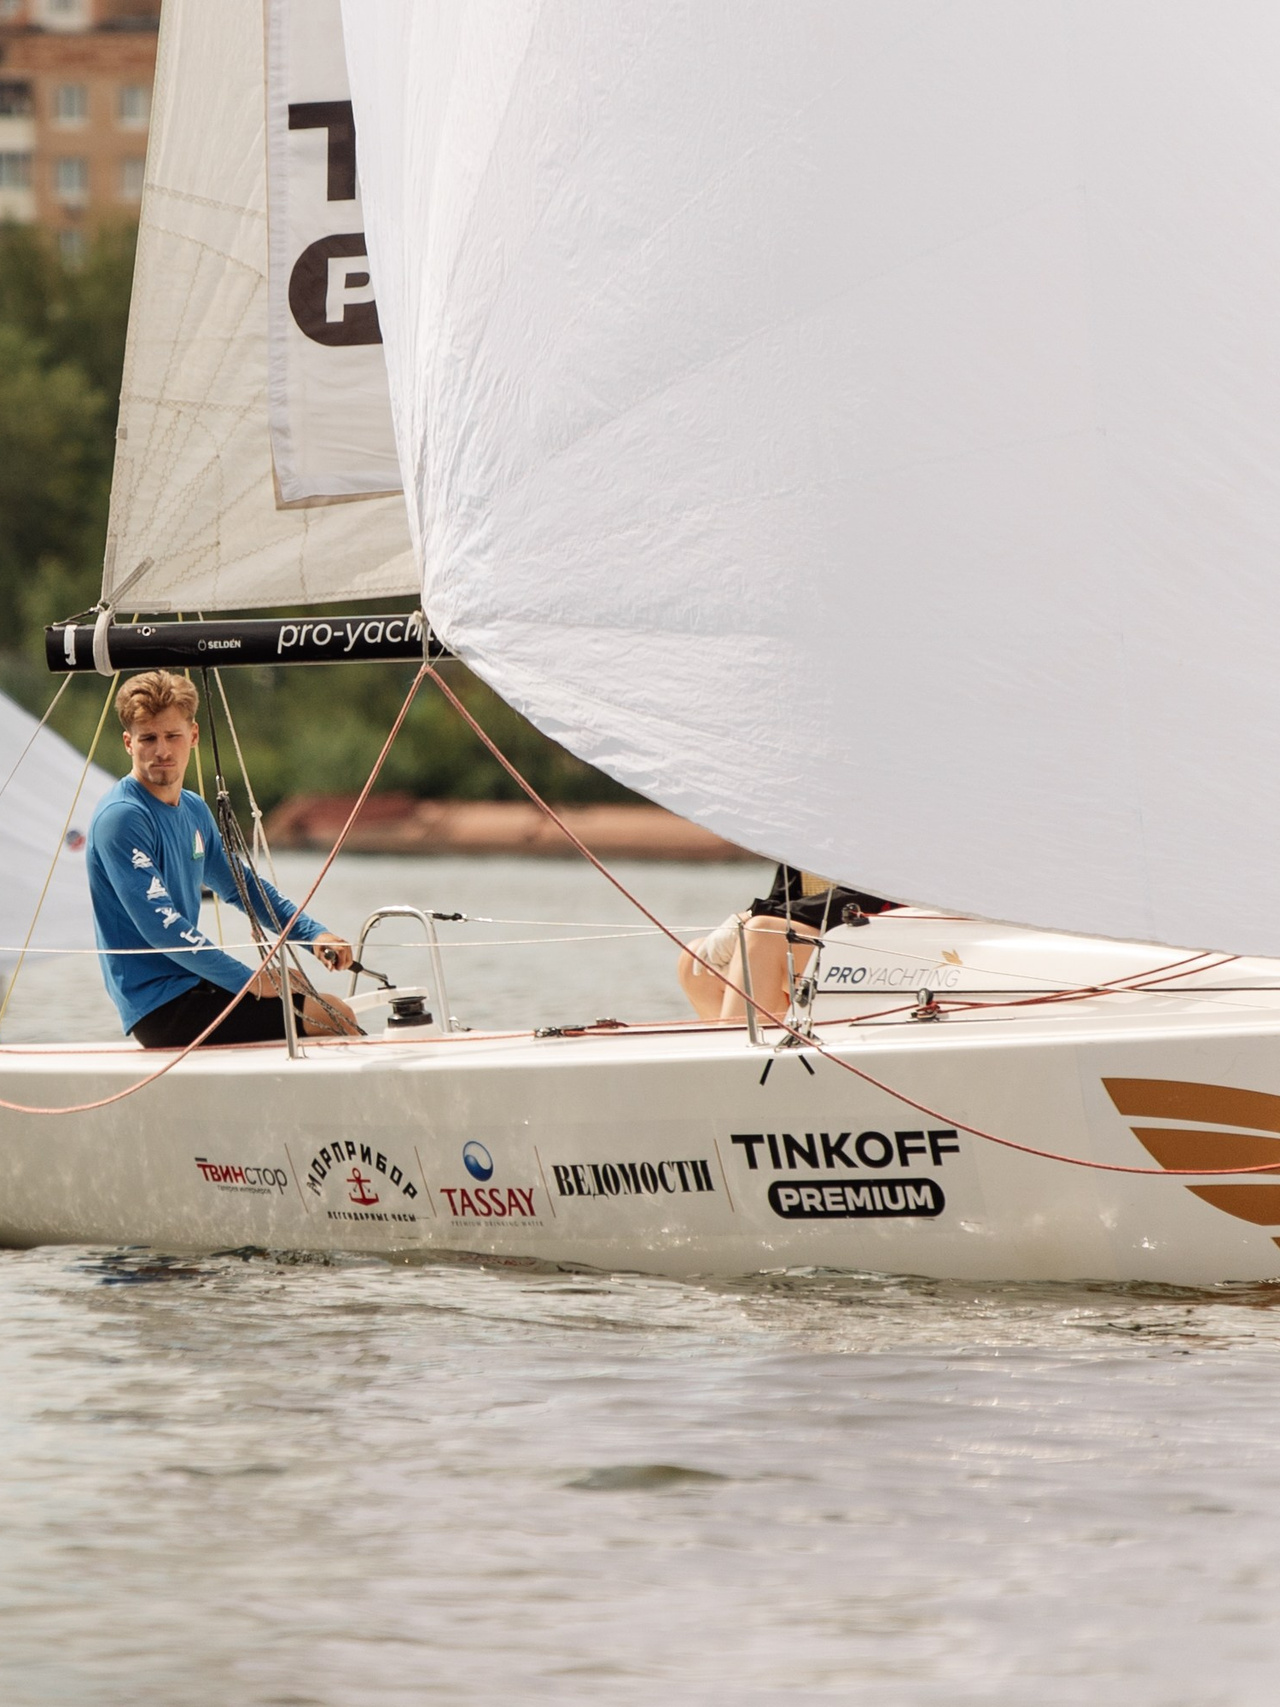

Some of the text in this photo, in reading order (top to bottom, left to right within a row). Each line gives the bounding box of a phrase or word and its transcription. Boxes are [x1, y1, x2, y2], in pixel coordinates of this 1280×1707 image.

[730, 1130, 960, 1170] TINKOFF
[306, 1141, 418, 1200] МОРПРИБОР
[552, 1159, 716, 1201] ВЕДОМОСТИ
[440, 1187, 537, 1217] TASSAY
[776, 1185, 936, 1213] PREMIUM
